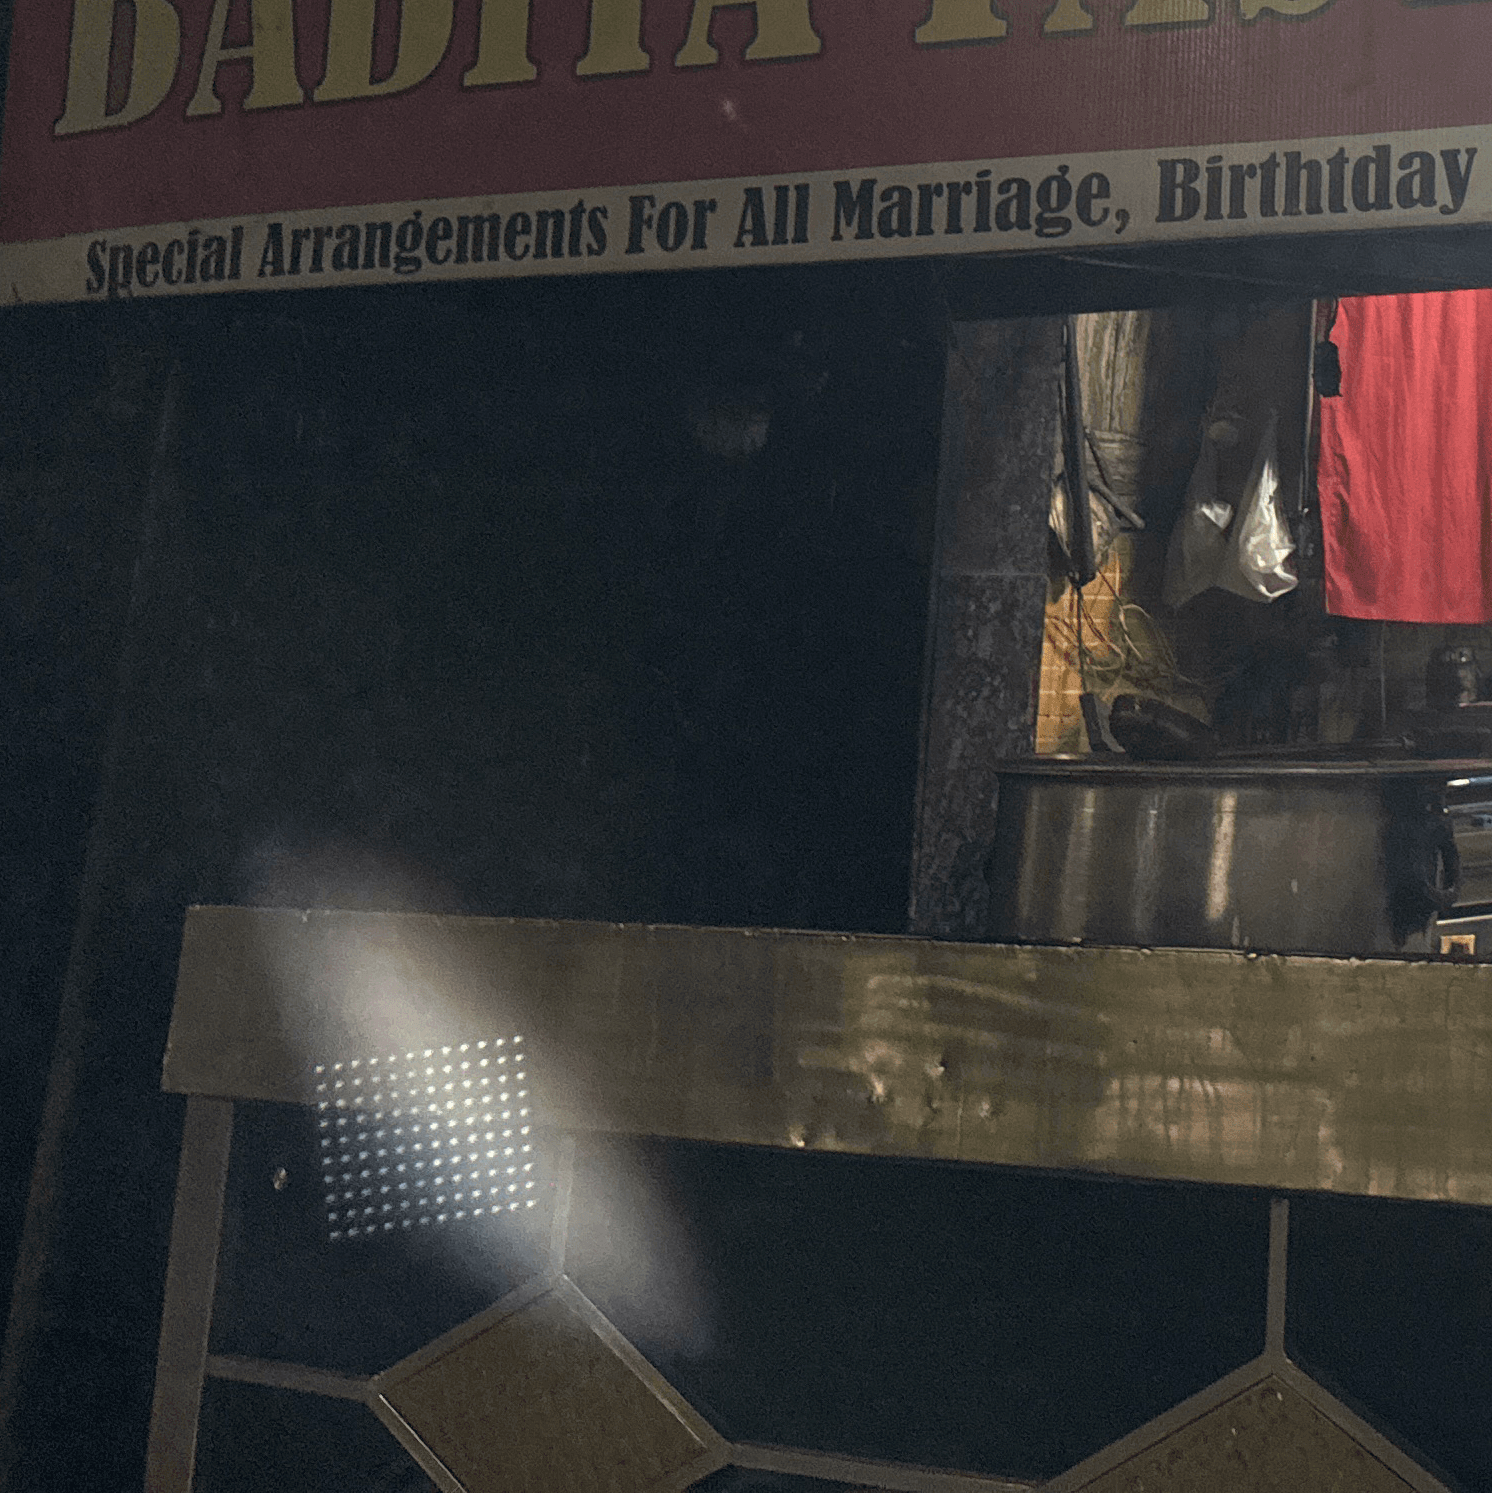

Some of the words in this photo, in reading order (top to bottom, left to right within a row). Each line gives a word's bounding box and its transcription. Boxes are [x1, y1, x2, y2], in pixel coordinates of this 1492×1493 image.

[85, 225, 244, 300] Special
[257, 199, 608, 274] Arrangements
[625, 194, 717, 254] For
[733, 182, 810, 248] All
[831, 164, 1131, 240] Marriage,
[1155, 144, 1478, 224] Birthtday
